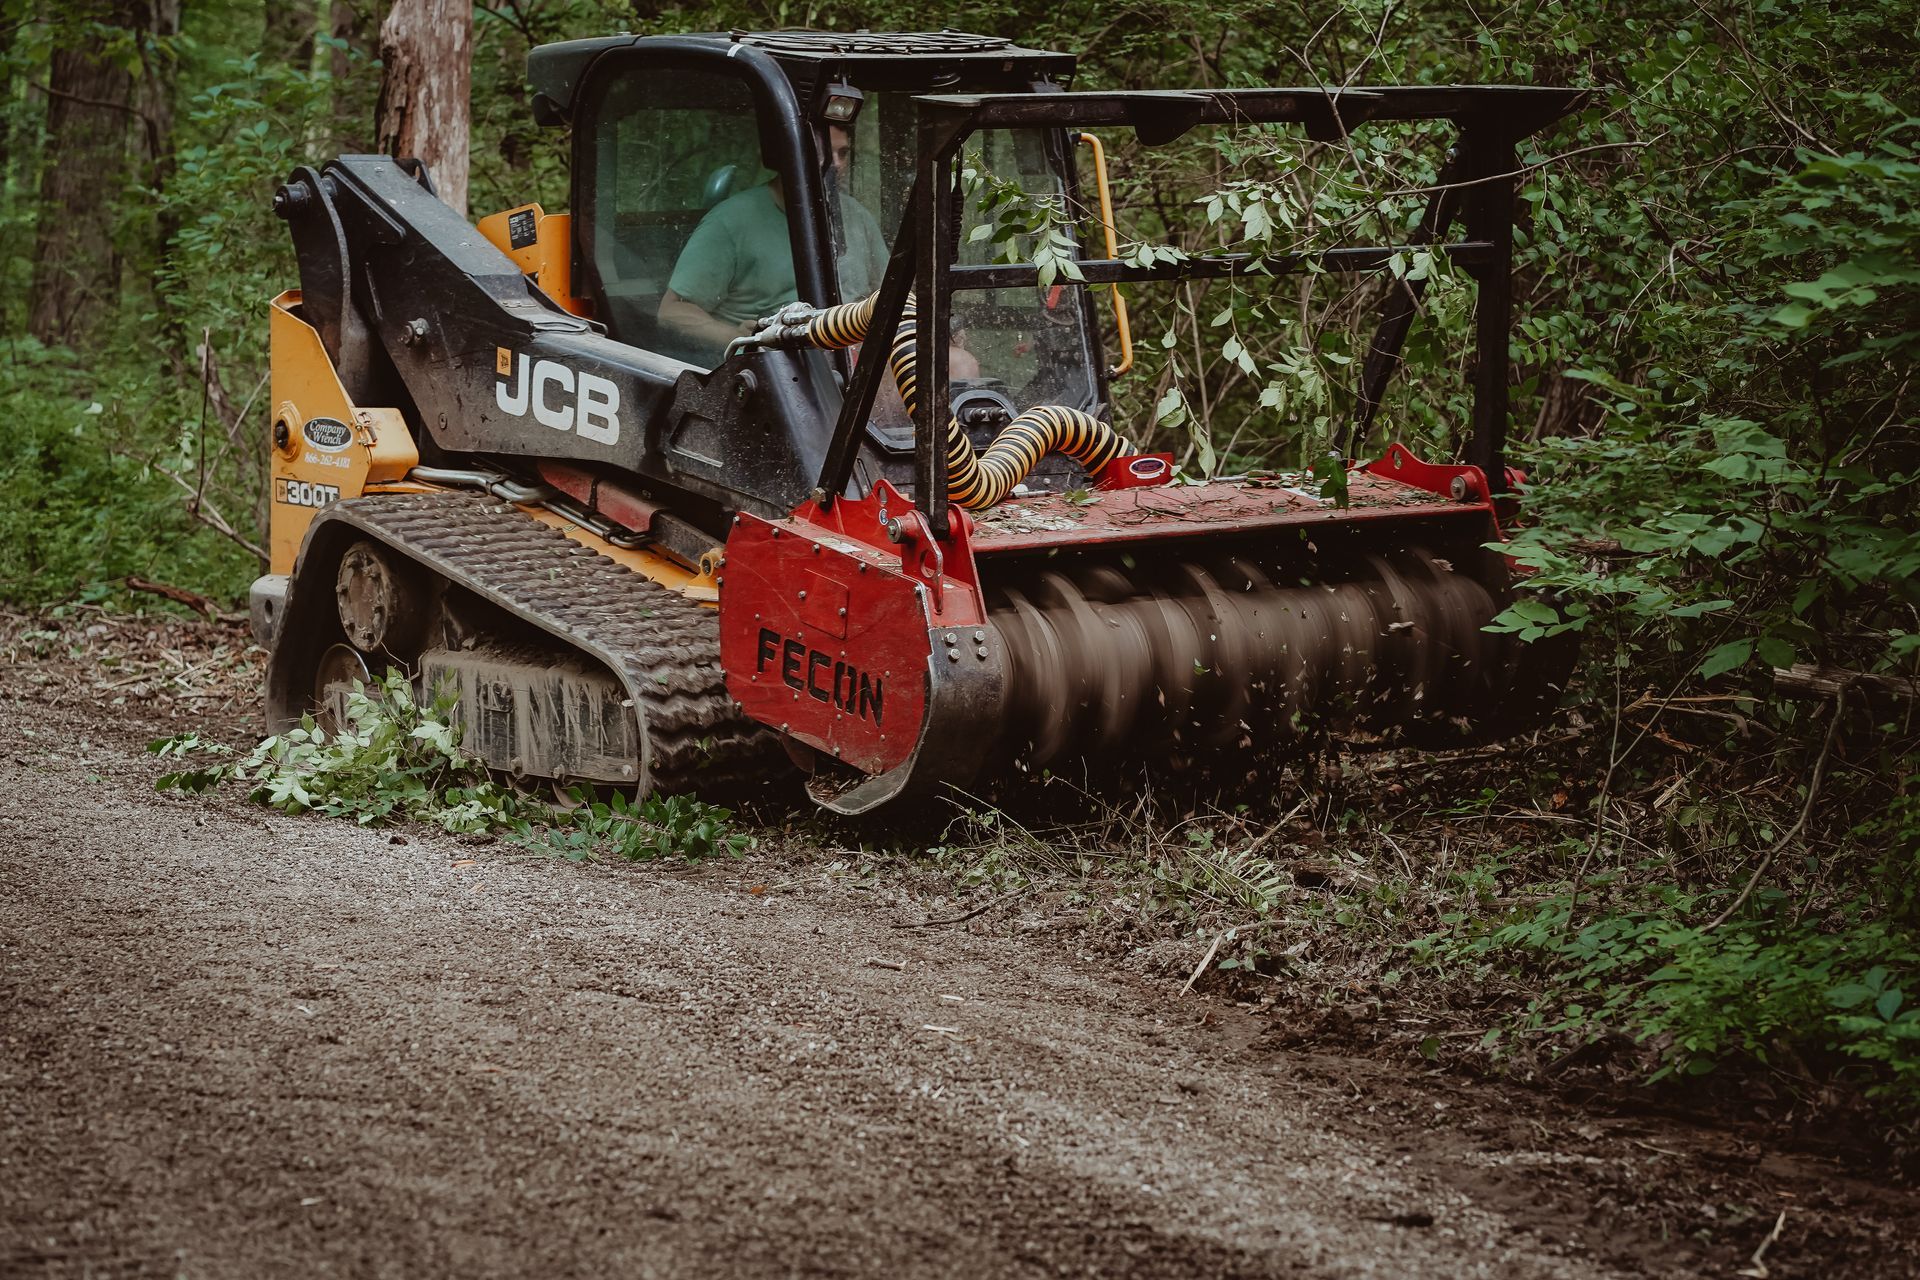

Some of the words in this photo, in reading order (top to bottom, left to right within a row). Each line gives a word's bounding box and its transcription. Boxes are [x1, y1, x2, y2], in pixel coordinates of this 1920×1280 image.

[495, 352, 621, 446] JCB
[310, 421, 346, 437] Company
[313, 431, 342, 444] Wrench
[287, 480, 338, 508] 300T
[757, 627, 884, 728] FECON
